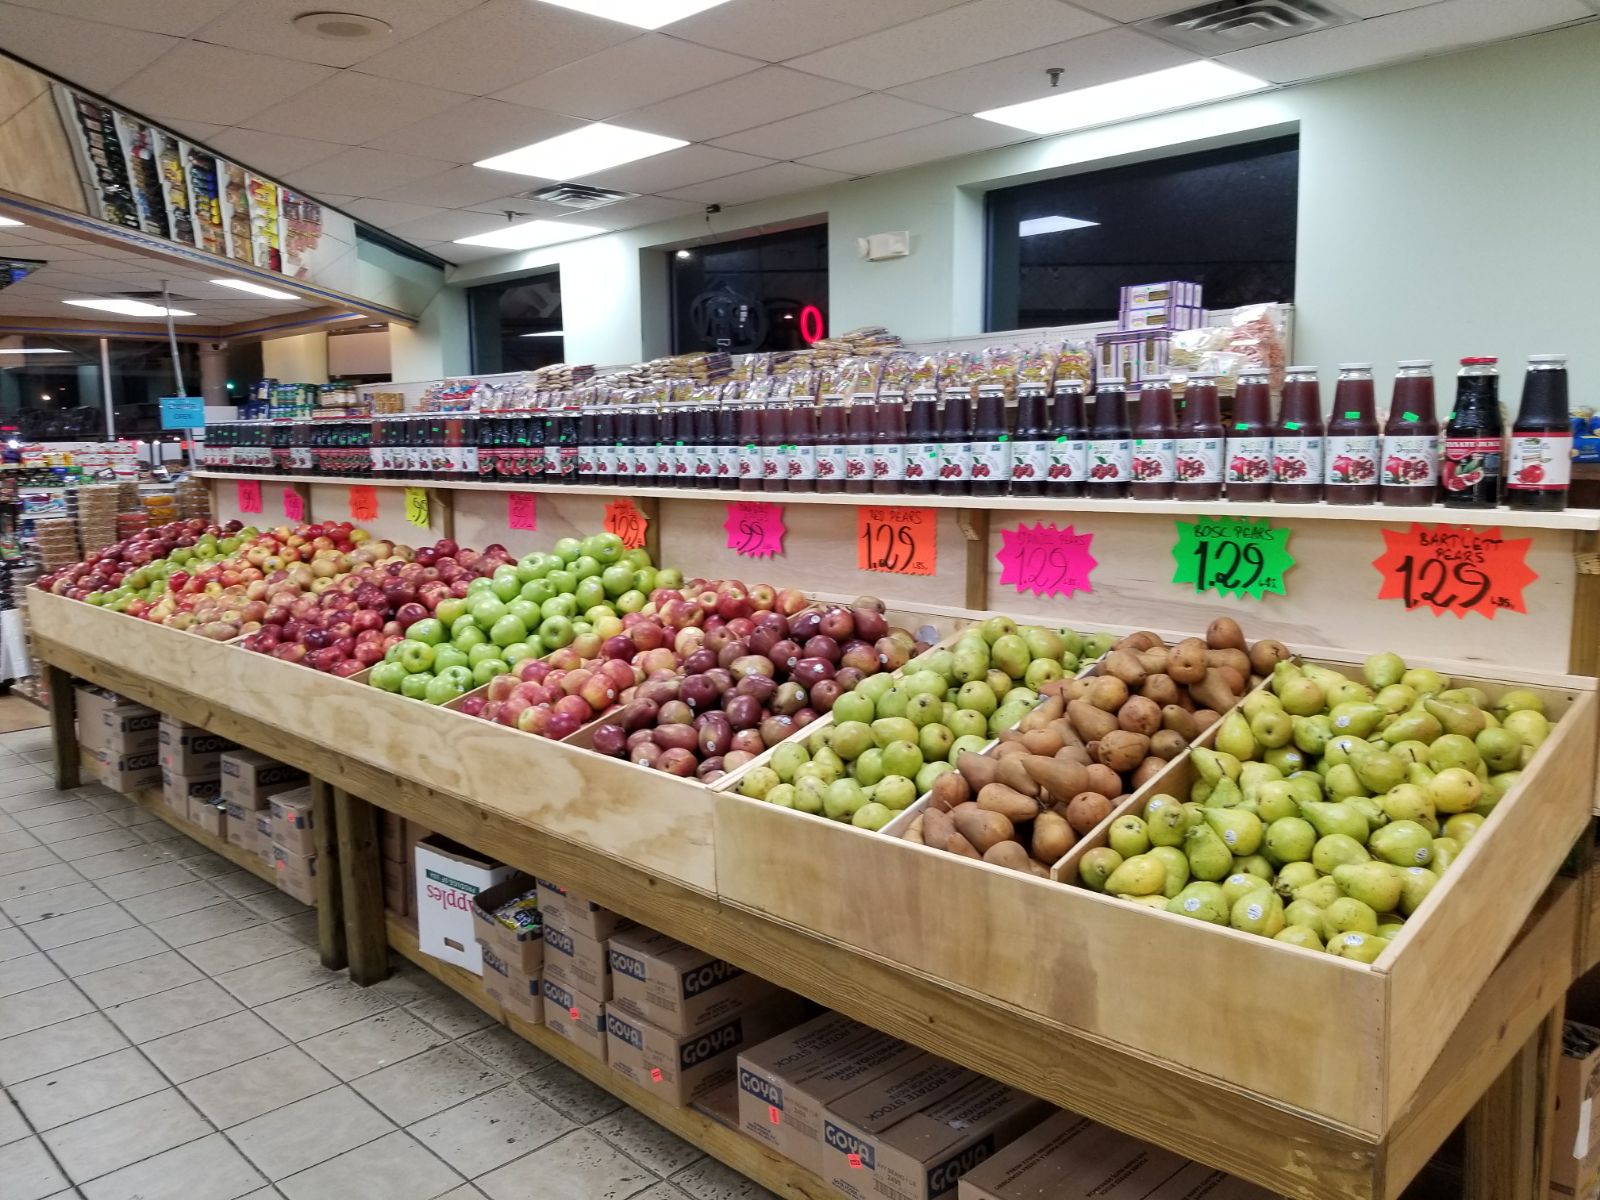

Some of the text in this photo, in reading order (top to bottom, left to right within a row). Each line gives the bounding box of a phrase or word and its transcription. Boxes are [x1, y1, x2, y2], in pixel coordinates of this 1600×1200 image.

[1193, 524, 1274, 541] BOSC PEARS
[1418, 532, 1505, 551] BARTLETT
[1435, 547, 1485, 563] PEARS
[545, 927, 573, 950] GOYA
[611, 951, 645, 978] GOYA
[544, 983, 572, 1009] GOYA
[608, 1017, 641, 1045] GOYA
[682, 1027, 736, 1063] GOYA
[741, 1072, 779, 1104] GOYA
[906, 1078, 948, 1102] ROTATE
[864, 1094, 908, 1122] STOCK
[826, 1125, 870, 1162] GOYA
[931, 1142, 988, 1190] GOYA
